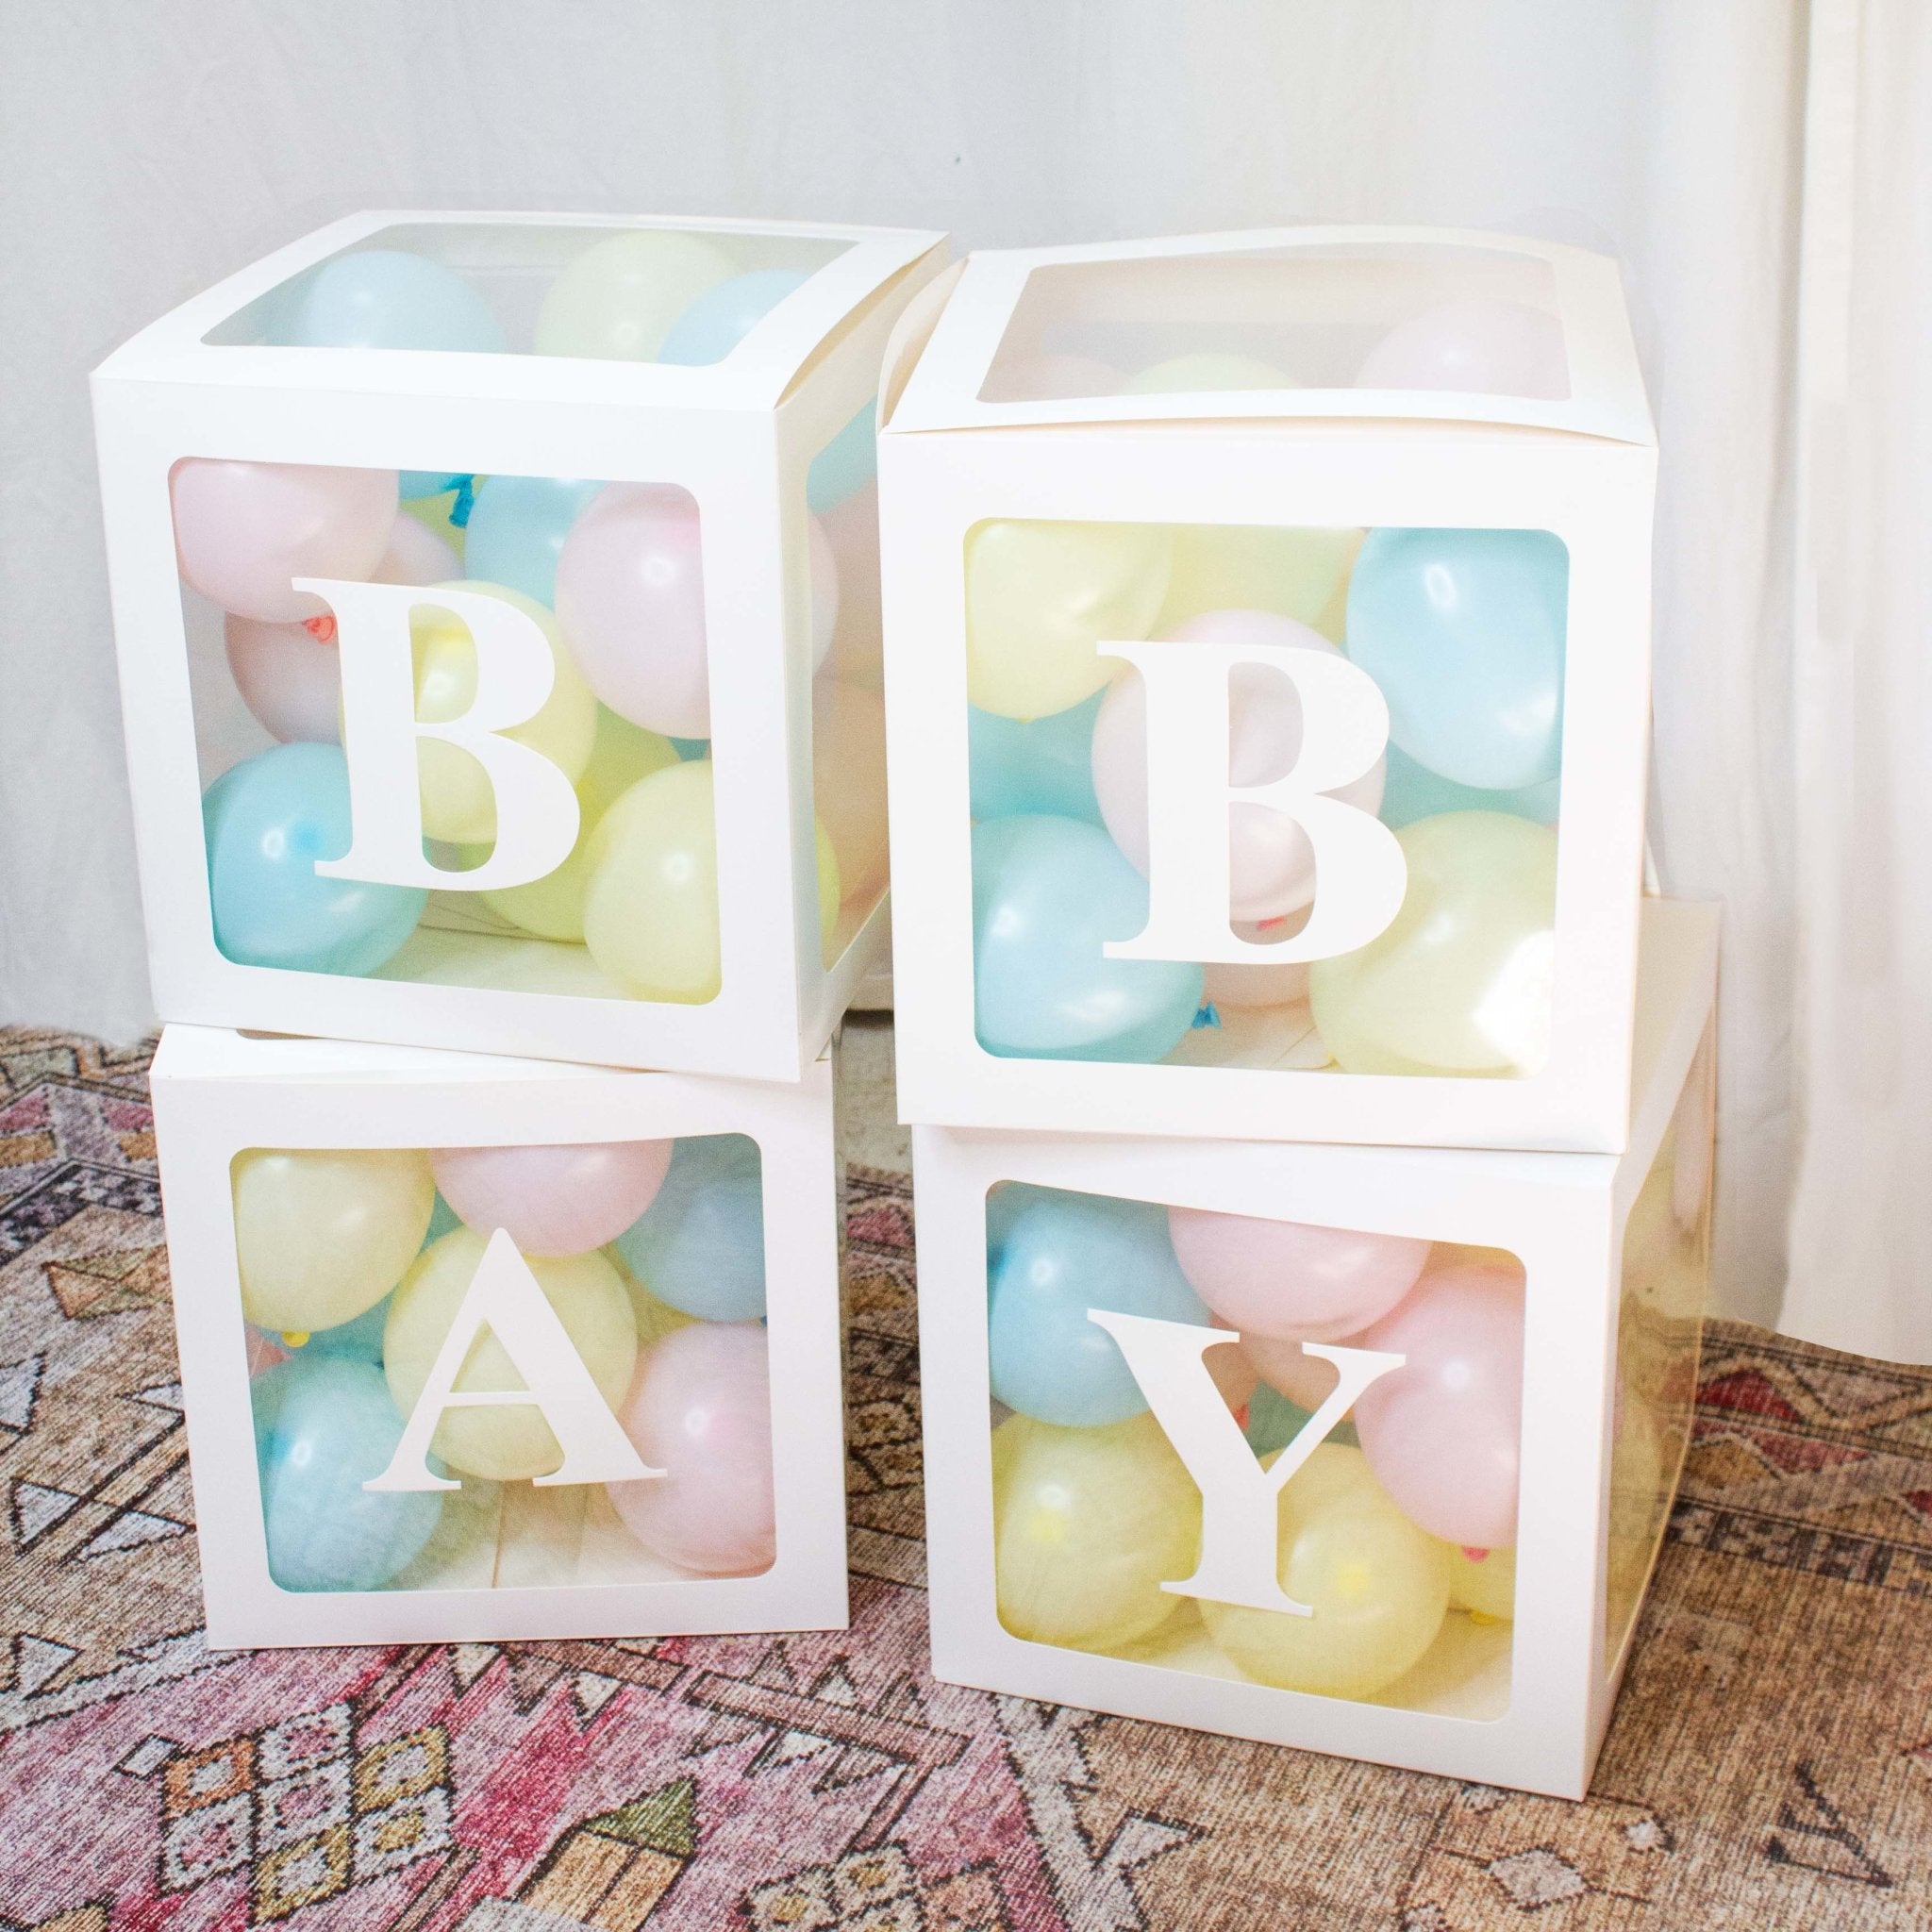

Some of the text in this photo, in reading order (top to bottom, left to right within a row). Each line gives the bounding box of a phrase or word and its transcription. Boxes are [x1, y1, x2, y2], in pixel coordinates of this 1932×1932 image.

[291, 576, 580, 891] B
[1096, 640, 1407, 965] B
[362, 1226, 668, 1491] A
[1087, 1307, 1407, 1618] Y
